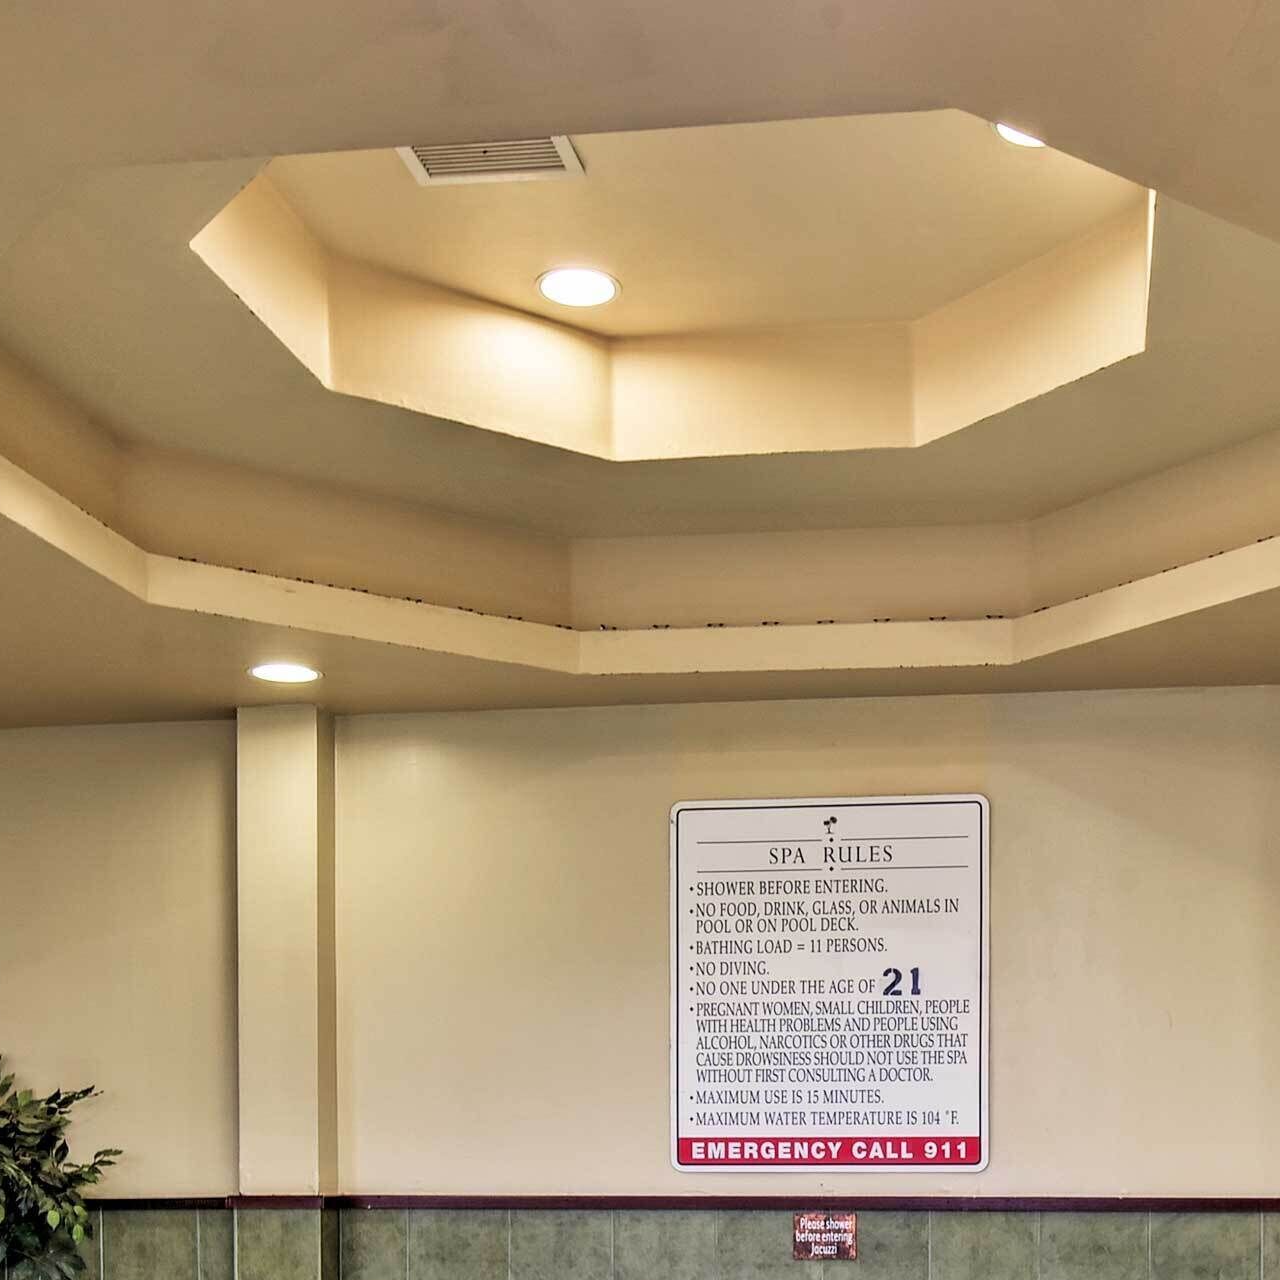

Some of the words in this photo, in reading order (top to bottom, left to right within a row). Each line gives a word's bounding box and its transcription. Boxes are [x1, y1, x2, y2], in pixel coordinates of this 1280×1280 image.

[769, 847, 806, 865] SPA
[823, 845, 894, 863] RULES
[696, 881, 755, 896] SHOWER
[759, 880, 810, 895] BEFORE
[815, 878, 888, 894] ENTERING.
[696, 902, 716, 918] NO
[720, 902, 760, 918] FOOD,
[764, 901, 809, 917] DRINK,
[812, 900, 856, 916] GLASS,
[859, 899, 878, 914] OR
[881, 898, 941, 914] ANIMALS
[944, 898, 959, 913] IN
[696, 919, 731, 934] POOL
[735, 919, 753, 934] OR
[757, 918, 777, 933] ON
[781, 917, 817, 933] POOL
[820, 917, 859, 932] DECK.
[696, 939, 753, 955] BATHING
[757, 938, 793, 954] LOAD
[797, 943, 805, 951] =
[810, 939, 821, 953] 11
[826, 937, 888, 953] PERSONS.
[696, 961, 716, 976] NO
[720, 960, 770, 976] DIVING.
[696, 980, 716, 996] NO
[720, 980, 748, 995] ONE
[751, 979, 796, 995] UNDER
[800, 979, 825, 994] THE
[828, 978, 854, 994] AGE
[858, 978, 876, 993] OF
[882, 966, 921, 996] 21
[696, 1001, 760, 1016] PREGNANT
[762, 1000, 814, 1017] WOMEN,
[815, 1000, 855, 1015] SMALL
[857, 999, 922, 1016] CHILDREN,
[925, 999, 970, 1014] PEOPLE
[696, 1018, 727, 1033] WITH
[730, 1018, 776, 1033] HEALTH
[779, 1017, 841, 1033] PROBLEMS
[843, 1016, 871, 1032] AND
[873, 1016, 918, 1031] PEOPLE
[921, 1015, 959, 1031] USING
[696, 1035, 757, 1051] ALCOHOL,
[759, 1034, 827, 1050] NARCOTICS
[829, 1034, 847, 1049] OR
[850, 1033, 891, 1049] OTHER
[893, 1033, 934, 1048] DRUGS
[936, 1033, 968, 1048] THAT
[696, 1051, 734, 1067] CAUSE
[736, 1051, 811, 1066] DROWSINESS
[813, 1050, 864, 1066] SHOULD
[867, 1050, 894, 1065] NOT
[896, 1050, 919, 1065] USE
[921, 1049, 945, 1065] THE
[946, 1049, 968, 1065] SPA
[696, 1068, 753, 1083] WITHOUT
[755, 1068, 786, 1083] FIRST
[788, 1067, 866, 1083] CONSULTING
[868, 1067, 877, 1082] A
[879, 1067, 934, 1082] DOCTOR.
[696, 1089, 760, 1105] MAXIMUM
[764, 1089, 788, 1104] USE
[792, 1089, 803, 1104] IS
[807, 1089, 819, 1104] 15
[823, 1088, 885, 1104] MINUTES.
[696, 1111, 760, 1126] MAXIMUM
[764, 1111, 807, 1126] WATER
[810, 1110, 902, 1126] TEMPERATURE
[907, 1110, 918, 1125] IS
[922, 1110, 941, 1125] 104
[691, 1140, 842, 1160] EMERGENCY
[851, 1140, 914, 1160] CALL
[923, 1140, 967, 1160] 911
[800, 1217, 825, 1230] Please
[826, 1217, 852, 1230] shower
[795, 1229, 821, 1242] before
[821, 1229, 853, 1245] entering
[810, 1242, 838, 1257] Jacuzzi
